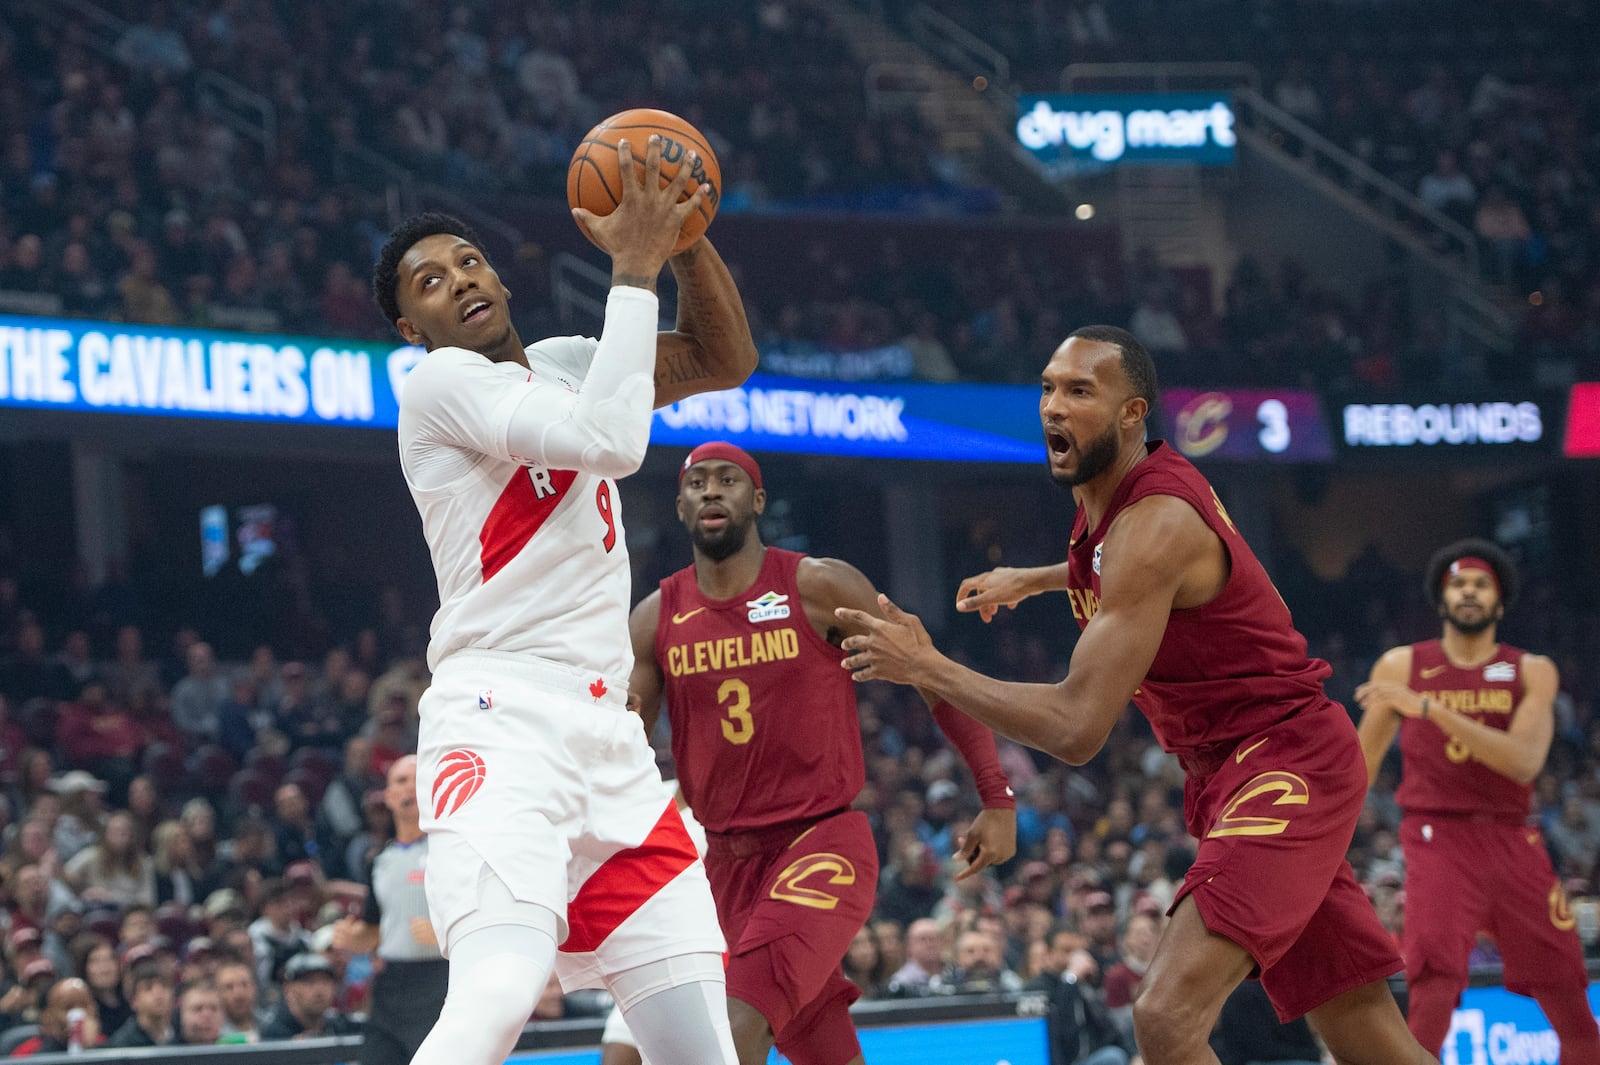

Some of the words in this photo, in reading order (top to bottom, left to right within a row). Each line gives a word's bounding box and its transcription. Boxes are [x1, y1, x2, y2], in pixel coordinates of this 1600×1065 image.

[1017, 101, 1124, 161] drug
[1126, 102, 1236, 147] mart
[78, 331, 308, 417] CAVALIERS
[310, 348, 374, 420] ON
[654, 387, 750, 433] ORTS
[750, 388, 908, 442] NETWORK
[1257, 399, 1290, 453] 3
[1344, 402, 1543, 446] REBOUNDS
[596, 479, 616, 554] 9
[750, 608, 788, 619] CLIFFS
[668, 627, 799, 677] CLEVELAND
[717, 678, 755, 745] 3
